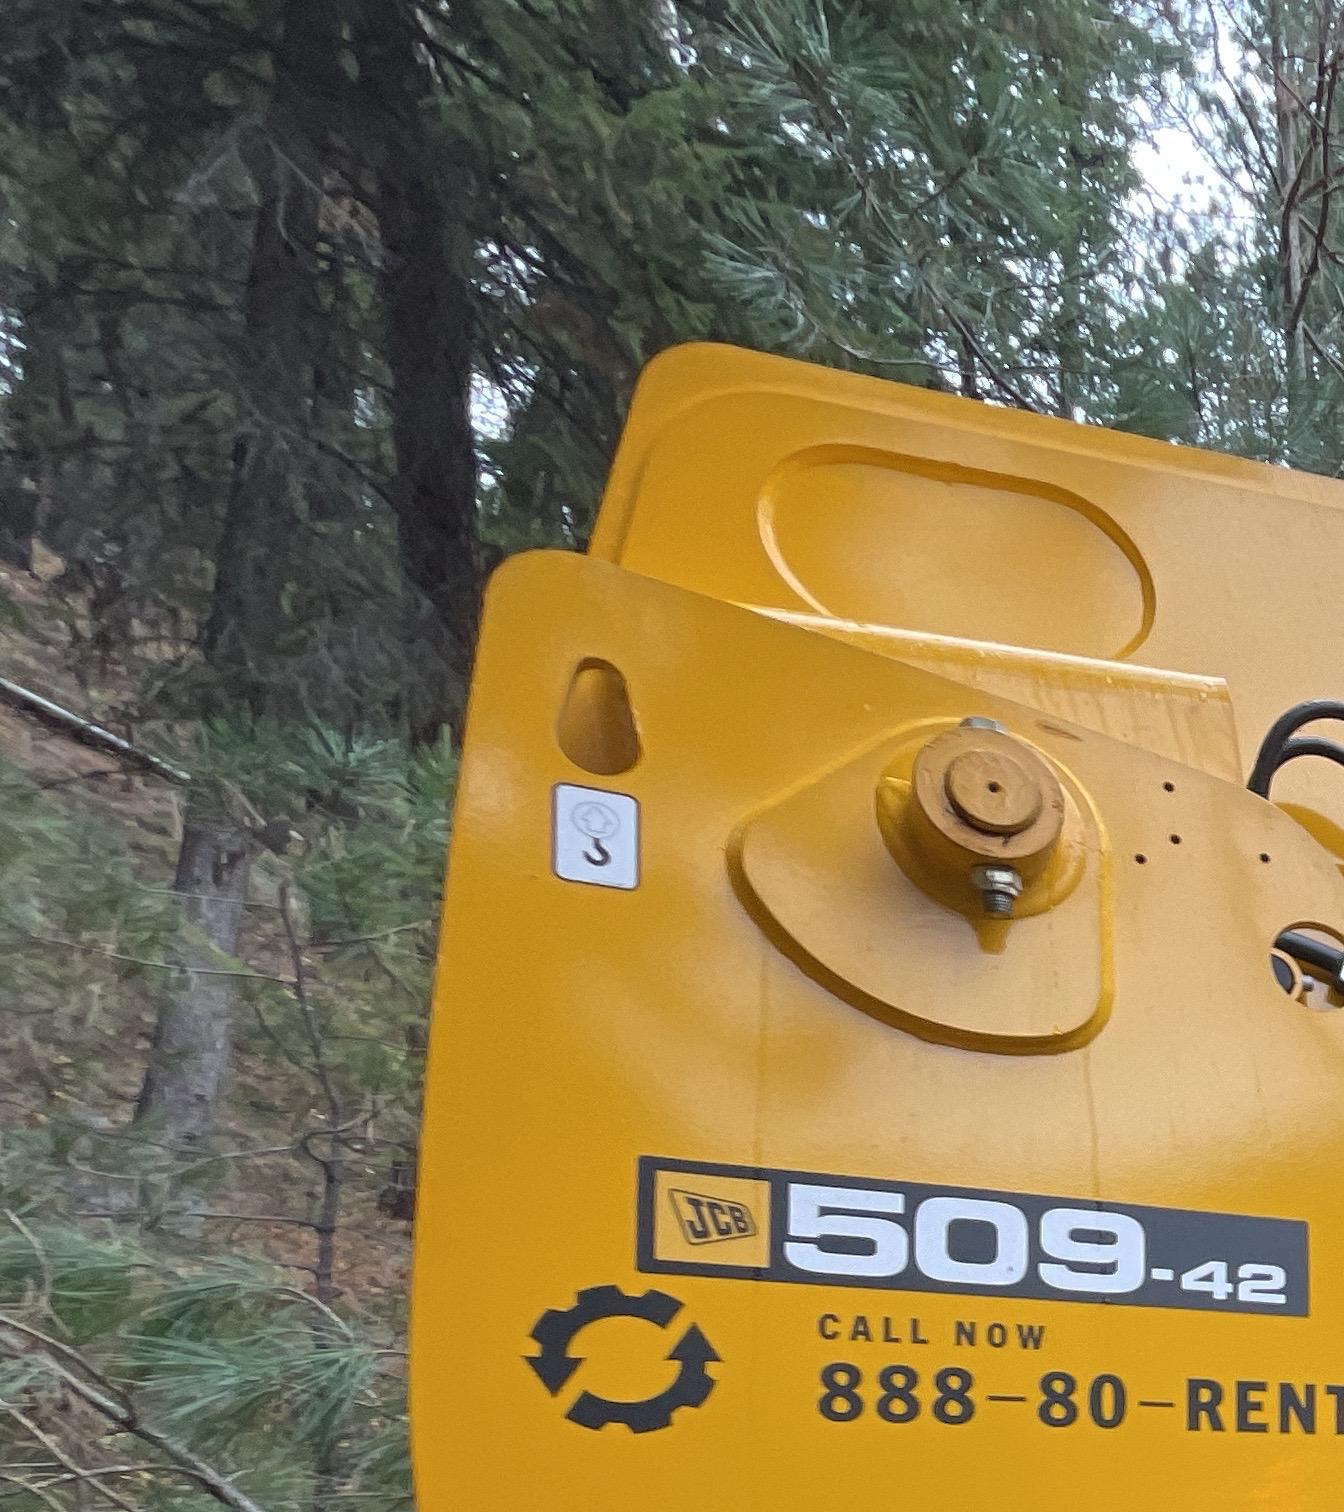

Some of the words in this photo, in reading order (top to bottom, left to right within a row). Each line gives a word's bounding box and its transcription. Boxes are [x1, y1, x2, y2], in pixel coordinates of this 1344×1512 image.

[686, 1196, 748, 1239] JCB
[783, 1182, 1288, 1304] 509-42
[817, 1313, 929, 1346] CALL
[953, 1320, 1048, 1351] NOW
